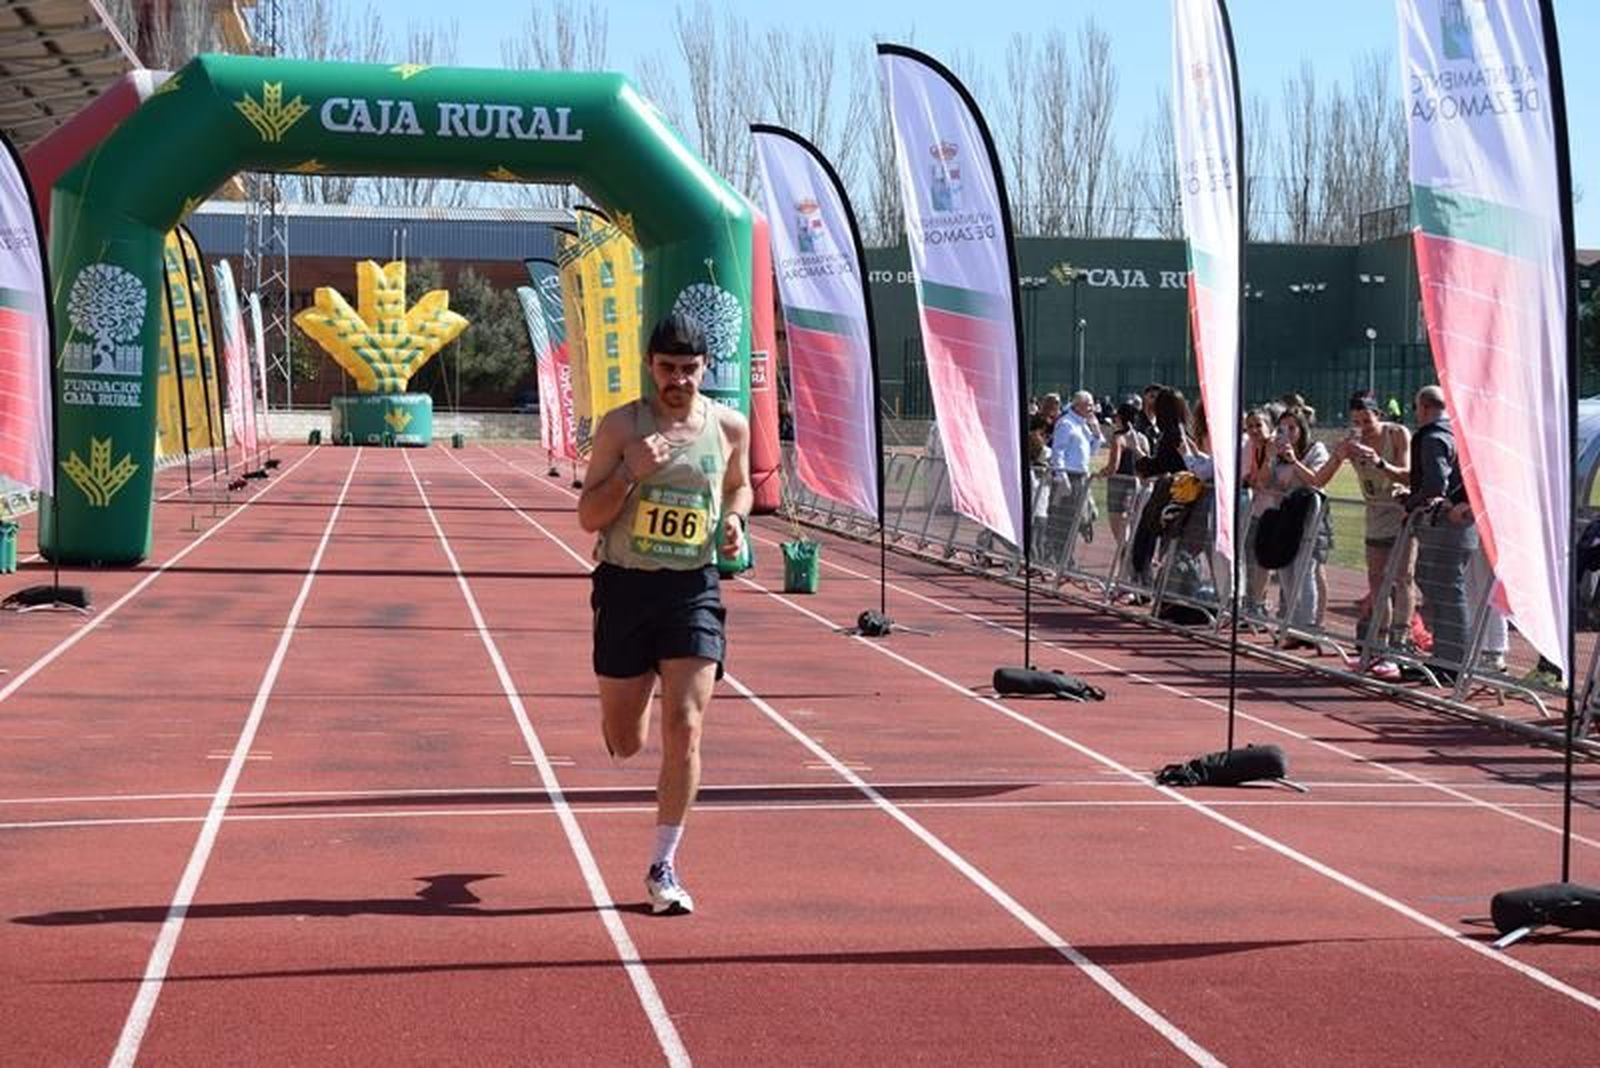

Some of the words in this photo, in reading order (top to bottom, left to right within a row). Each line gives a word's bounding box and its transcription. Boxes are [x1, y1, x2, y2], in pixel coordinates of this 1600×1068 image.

[320, 97, 424, 136] CAJA
[437, 101, 583, 141] RURAL
[1087, 268, 1150, 289] CAJA
[63, 391, 95, 405] CAJA
[97, 393, 142, 407] RURAL
[646, 507, 697, 540] 166
